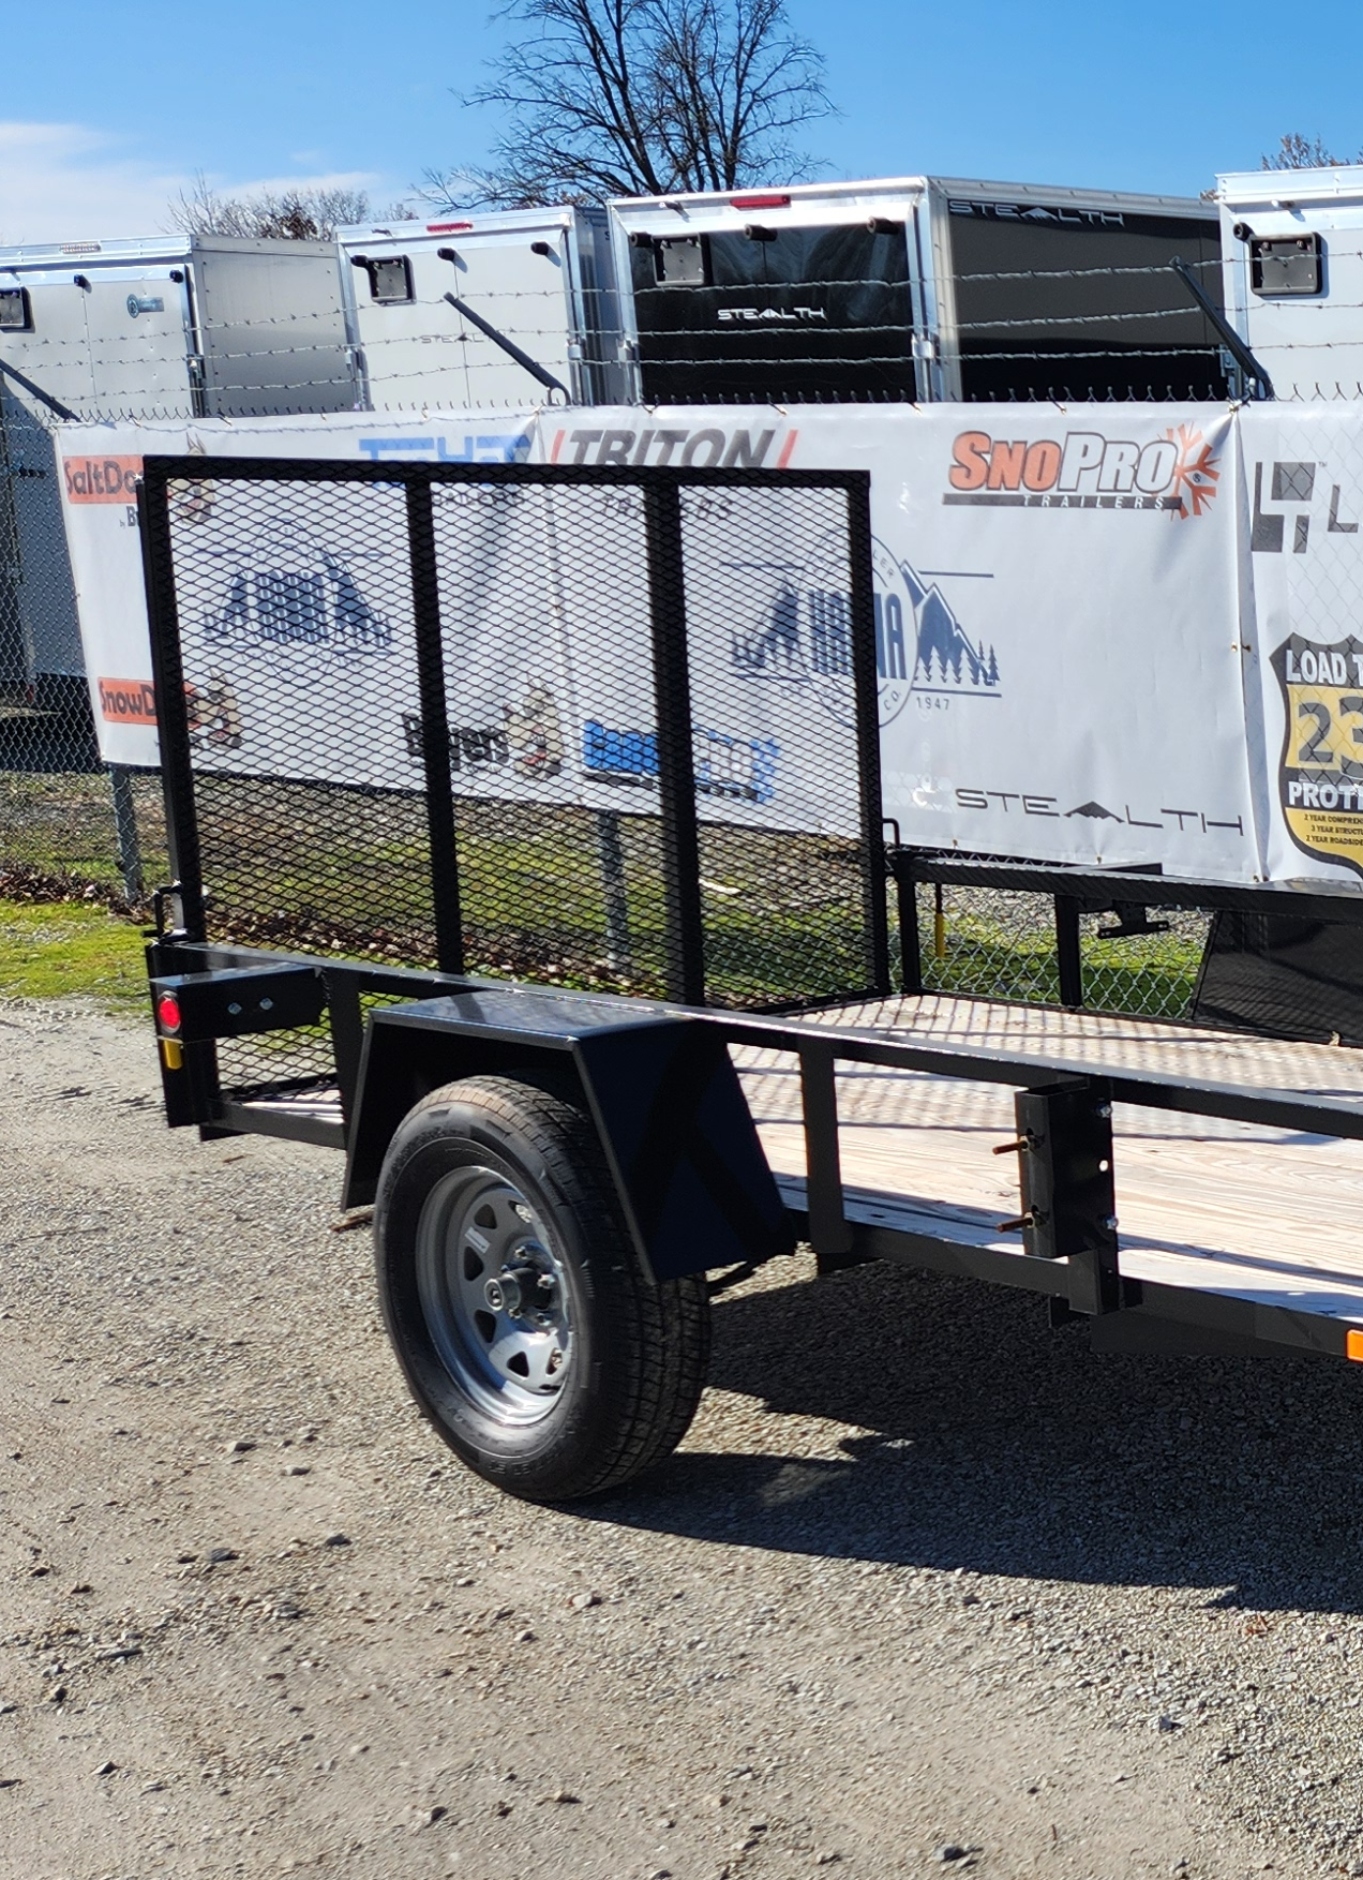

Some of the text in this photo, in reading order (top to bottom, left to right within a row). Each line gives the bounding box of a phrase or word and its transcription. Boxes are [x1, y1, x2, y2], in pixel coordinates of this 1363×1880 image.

[950, 201, 1125, 227] STEALTH
[718, 307, 827, 320] STEALTH
[570, 429, 775, 467] TRITON
[64, 460, 143, 495] SaltDo
[1023, 494, 1165, 509] TRAILERS
[1286, 649, 1347, 686] LOAD
[99, 681, 157, 717] SnowD
[916, 696, 950, 710] 1947
[955, 788, 1244, 836] STEALTH
[1310, 814, 1326, 822] YEAR
[1311, 835, 1329, 843] YEAR
[1317, 825, 1334, 833] YEAR
